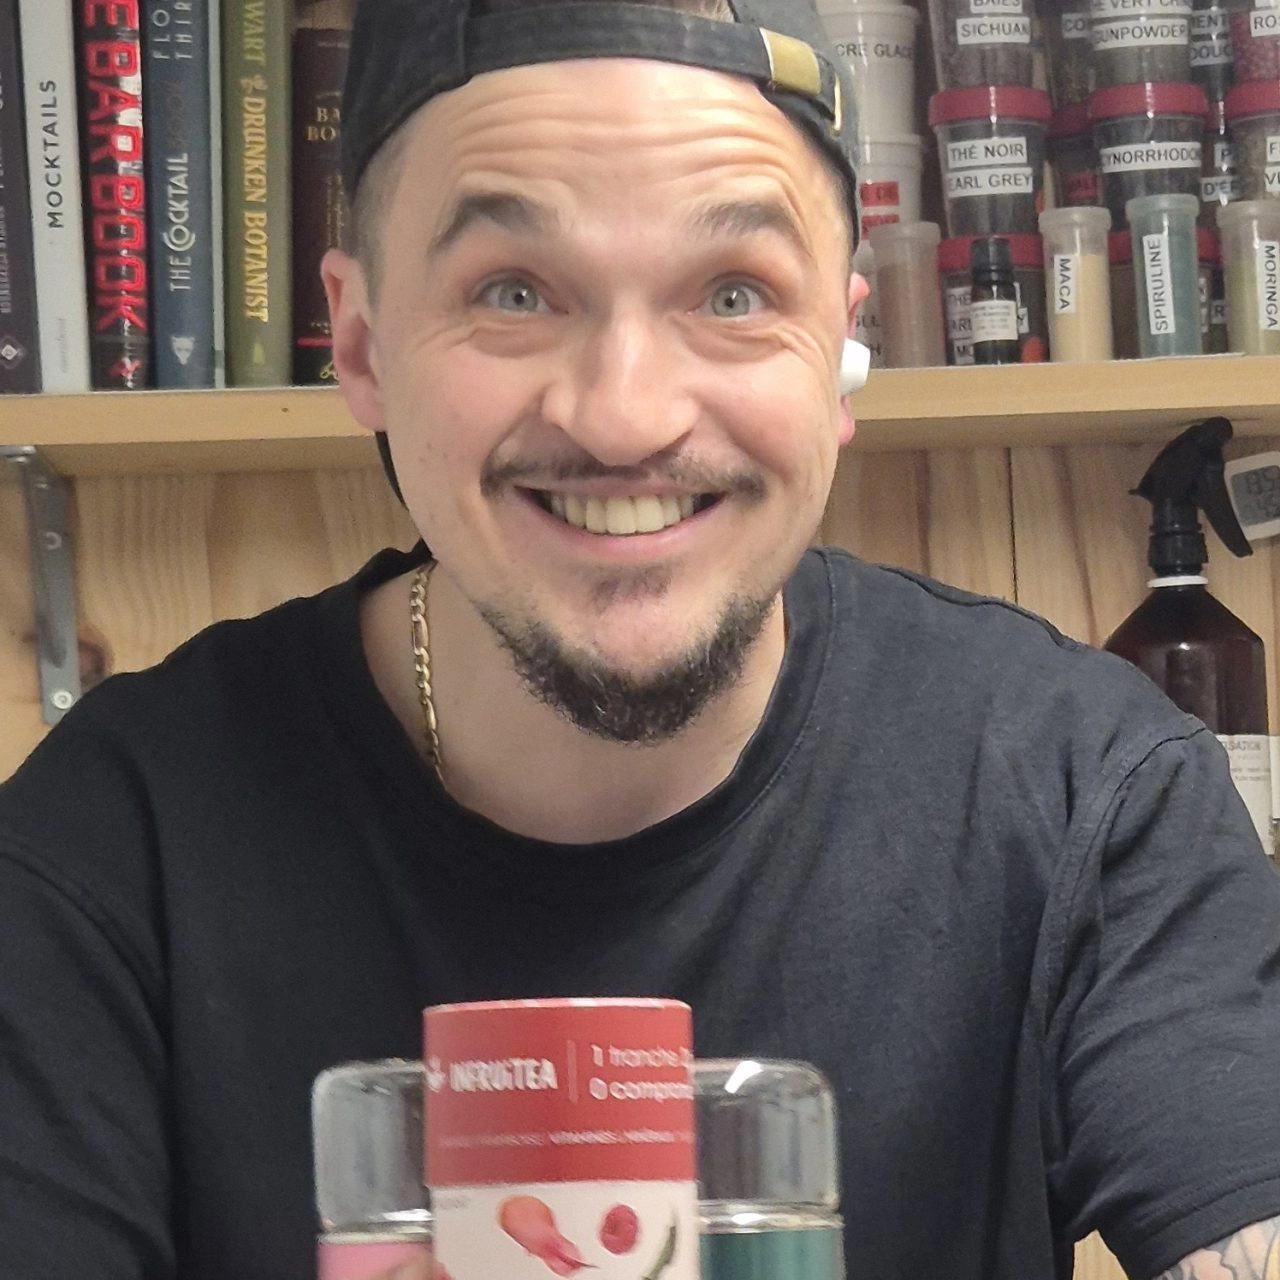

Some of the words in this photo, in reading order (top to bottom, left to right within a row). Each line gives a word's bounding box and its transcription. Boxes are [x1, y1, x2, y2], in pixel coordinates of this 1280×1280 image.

[40, 79, 63, 230] MOCKTAILS
[244, 97, 267, 203] DRUNKEN
[984, 142, 1025, 158] NOIR
[987, 171, 1032, 188] GREY
[163, 152, 196, 252] COCKTAIL
[169, 255, 192, 292] THE
[245, 212, 269, 323] BOTANIST
[1059, 258, 1070, 310] MACA
[1147, 238, 1169, 332] SPIRULINE
[1264, 245, 1279, 328] MORINGA
